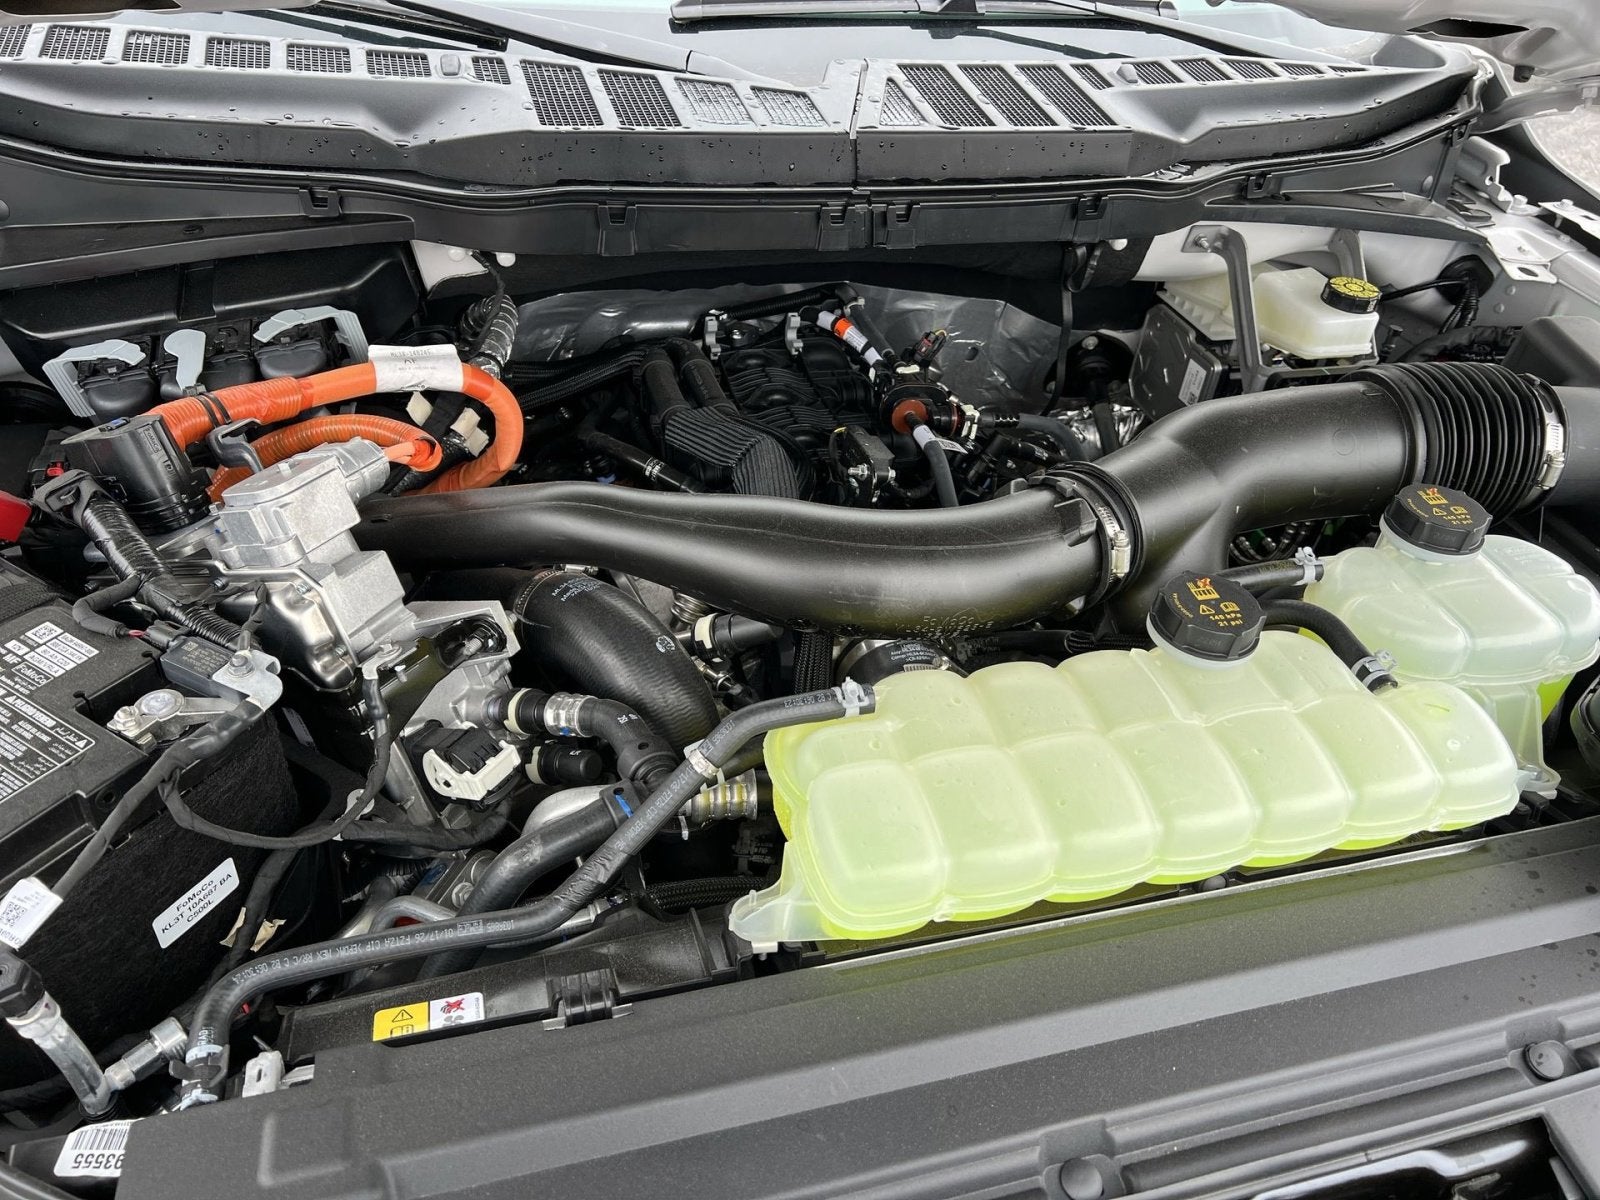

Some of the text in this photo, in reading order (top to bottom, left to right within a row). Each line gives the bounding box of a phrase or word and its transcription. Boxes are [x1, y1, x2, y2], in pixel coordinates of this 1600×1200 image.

[1209, 613, 1225, 621] 145
[1230, 619, 1244, 627] psi
[161, 873, 233, 934] KL3T 10A687 BA
[176, 880, 214, 912] FoMoCo
[186, 900, 214, 923] C500L
